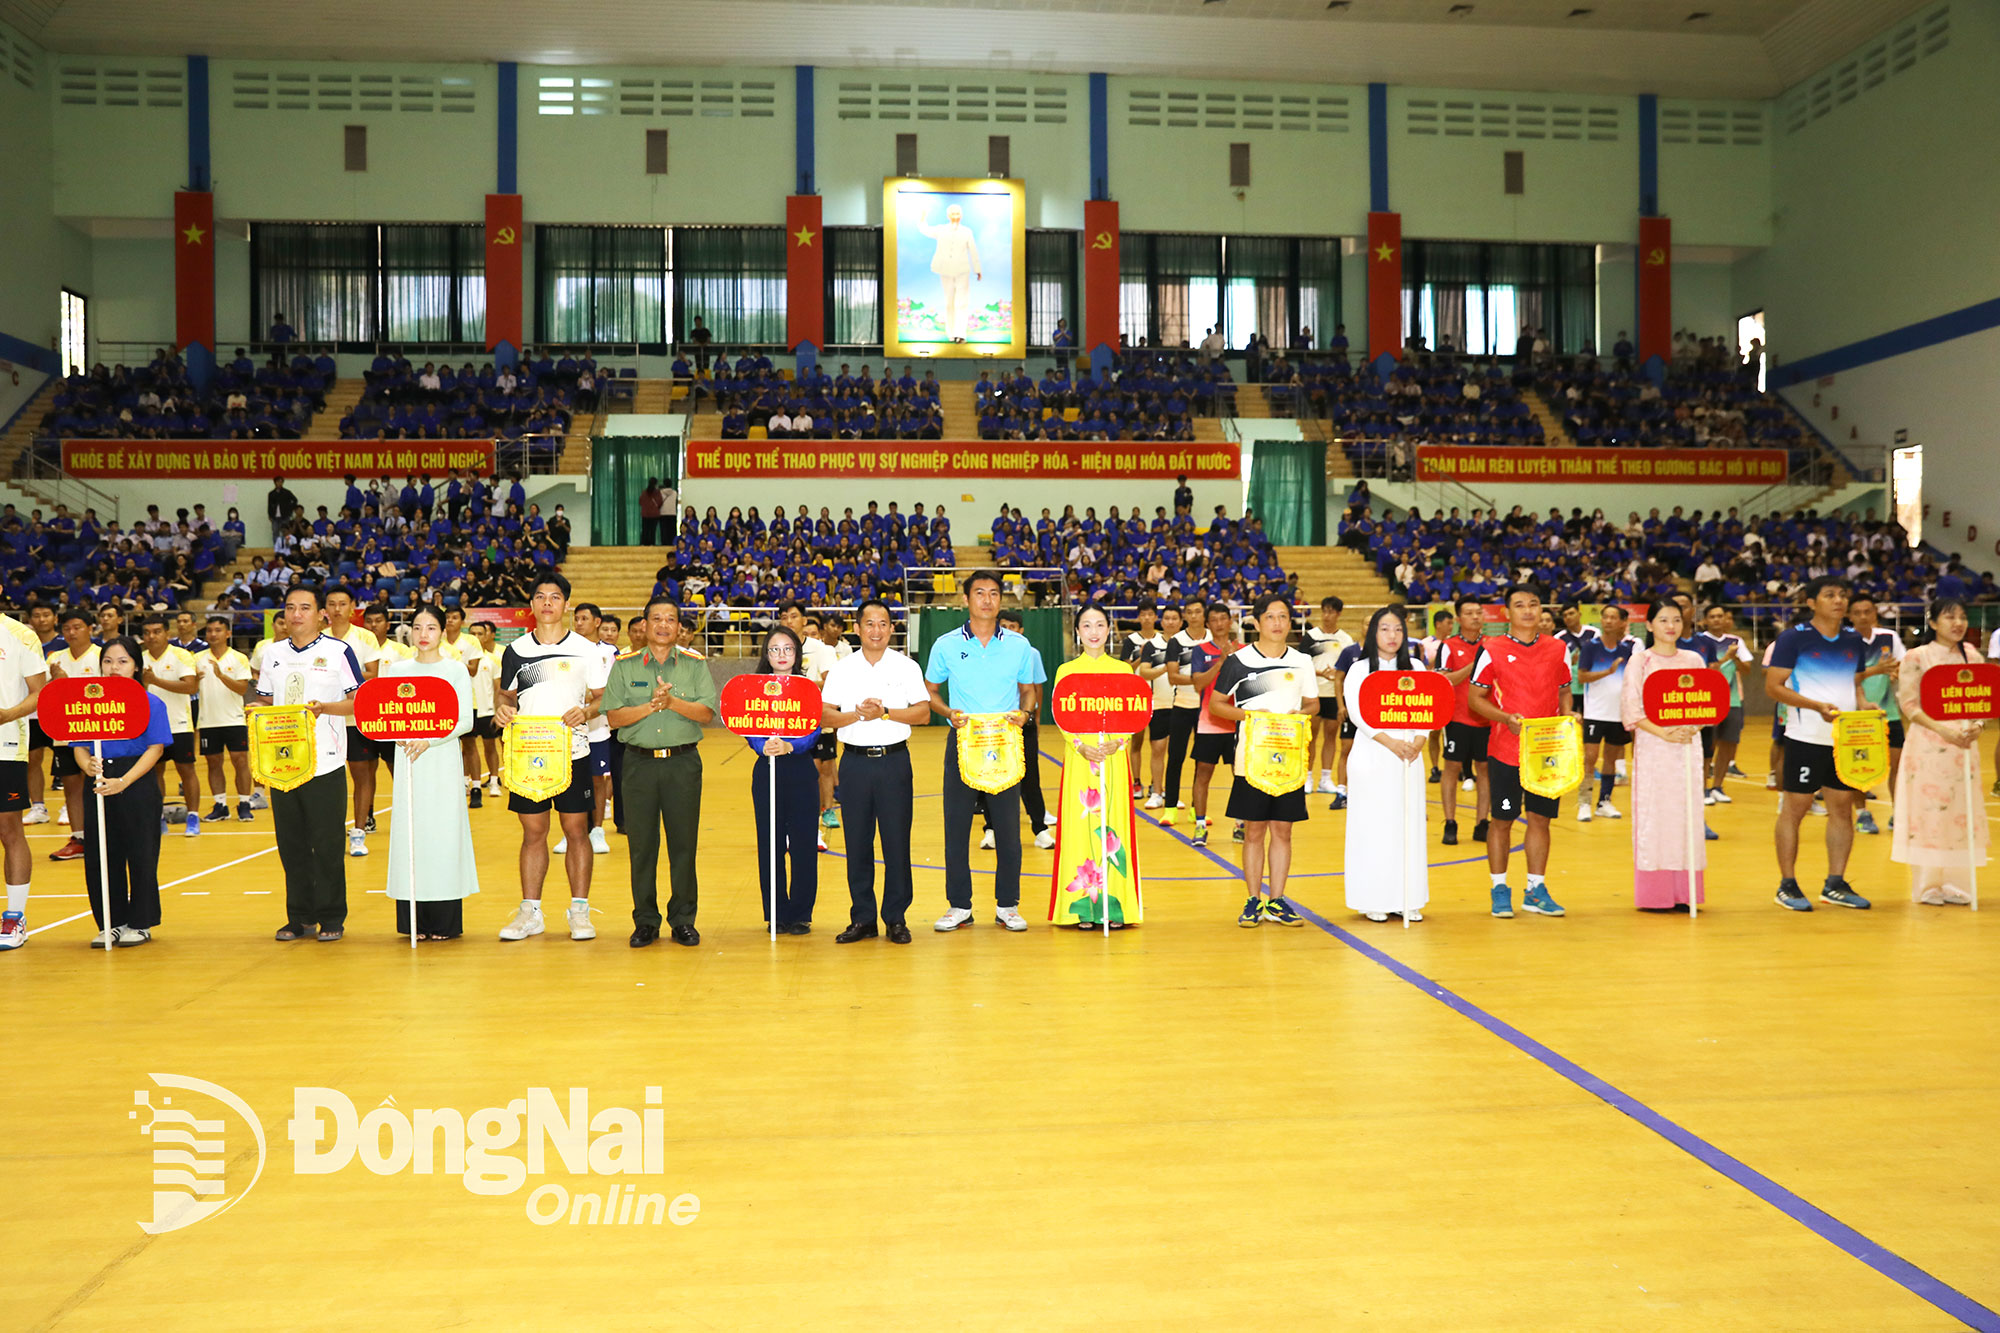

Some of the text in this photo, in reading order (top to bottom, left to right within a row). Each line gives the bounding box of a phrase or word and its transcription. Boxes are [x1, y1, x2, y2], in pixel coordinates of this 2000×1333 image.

[71, 447, 487, 473] KHỎE ĐỂ XÂY DỰNG VÀ BẢO VỆ TỔ QUỐC VIỆT NAM XÃ HỘI CHỦ NGHĨA
[696, 446, 722, 469] THỂ
[724, 452, 751, 472] DỤC
[755, 446, 780, 469] THỂ
[782, 452, 816, 469] THAO
[819, 452, 855, 472] PHỤC
[858, 452, 876, 472] VỤ
[879, 451, 899, 472] SỰ
[900, 450, 949, 473] NGHIỆP
[952, 450, 988, 469] CÔNG
[991, 450, 1040, 473] NGHIỆP
[1043, 451, 1069, 470] HÓA
[1081, 451, 1112, 473] HIỆN
[1114, 454, 1136, 473] ĐẠI
[1140, 451, 1166, 470] HÓA
[1169, 449, 1193, 470] ĐẤT
[1196, 451, 1231, 470] NƯỚC
[1942, 511, 1952, 528] E
[1968, 525, 1978, 542] D
[1663, 689, 1711, 703] LIÊN QUÂN
[1941, 684, 1991, 698] LIÊN QUÂN
[745, 698, 801, 712] LIÊN QUÂN
[1059, 692, 1148, 714] TỔ TRỌNG TÀI
[1380, 692, 1433, 707] LIÊN QUÂN
[65, 700, 126, 715] LIÊN QUÂN
[379, 700, 436, 715] LIÊN QUÂN
[1380, 708, 1433, 722] ĐỒNG XOÀI
[1658, 705, 1717, 719] LONG KHÁNH
[1943, 701, 1962, 714] TÂN
[68, 718, 125, 734] XUÂN LỘC
[361, 716, 454, 732] KHỐI TM-XDLL-HC
[728, 713, 817, 730] KHỐI CẢNH SÁT 2
[1447, 741, 1455, 753] 3
[1799, 766, 1810, 783] 2
